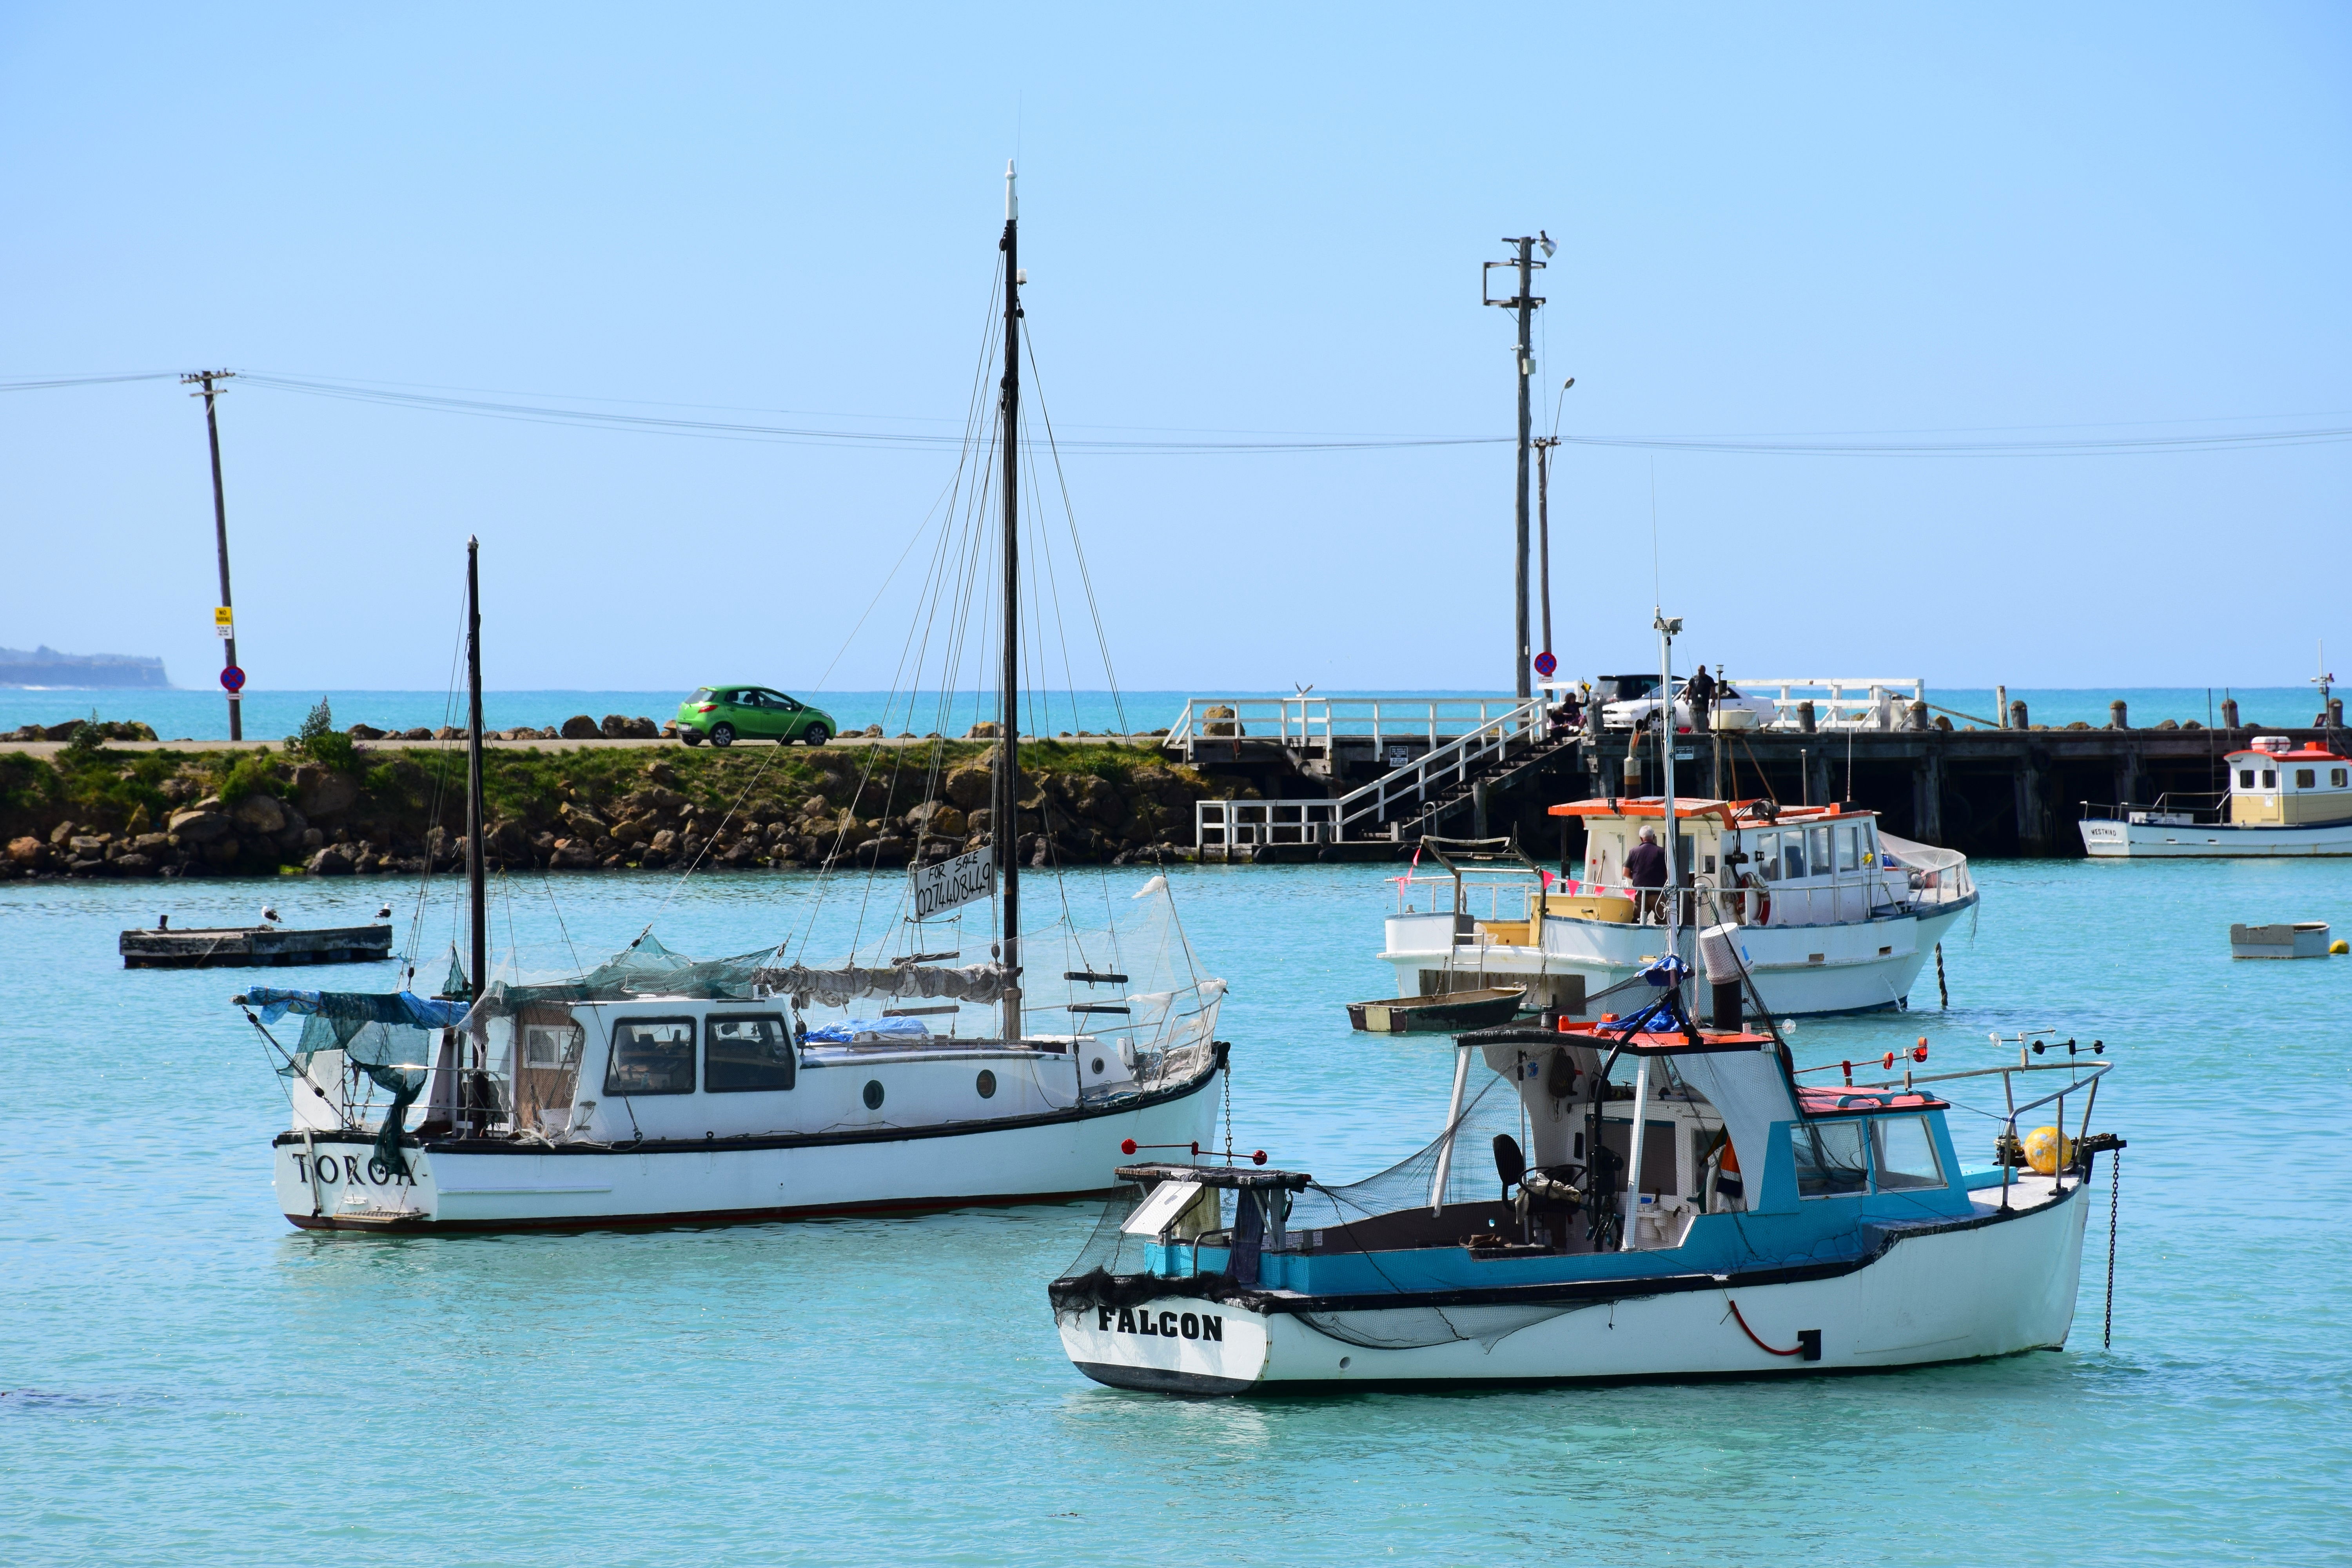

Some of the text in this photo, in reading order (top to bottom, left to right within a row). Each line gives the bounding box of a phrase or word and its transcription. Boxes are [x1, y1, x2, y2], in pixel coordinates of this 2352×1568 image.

[928, 851, 979, 882] FOR SALE
[918, 862, 991, 916] 0274408449
[292, 1153, 417, 1186] TOROA
[1097, 1305, 1223, 1342] FALCON
